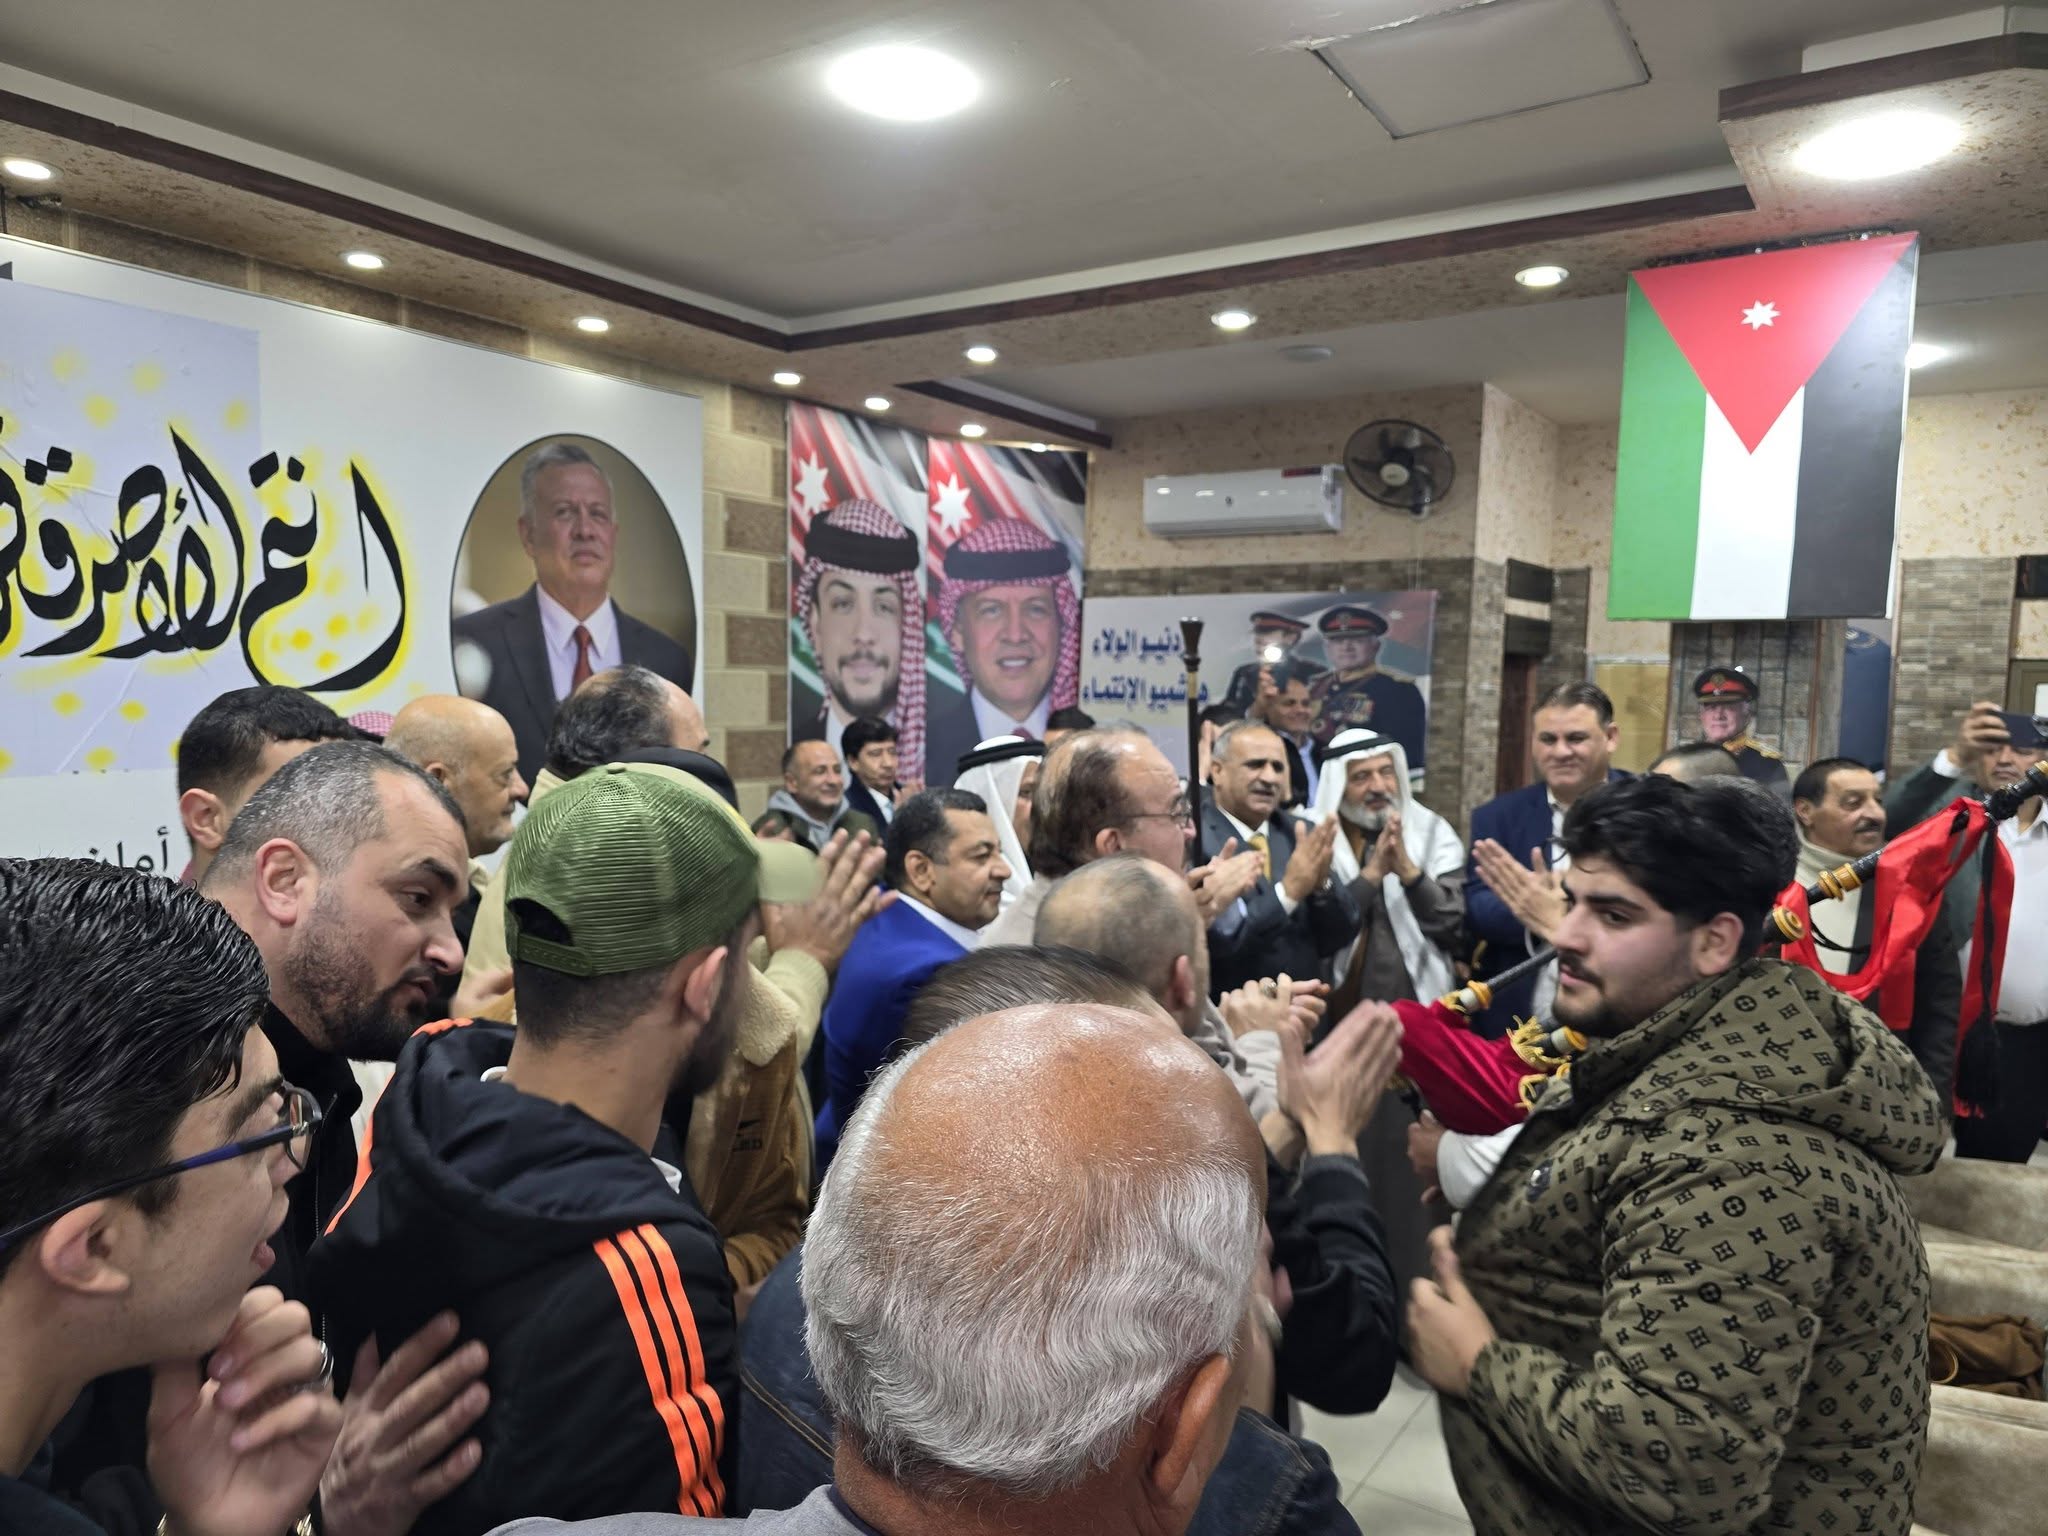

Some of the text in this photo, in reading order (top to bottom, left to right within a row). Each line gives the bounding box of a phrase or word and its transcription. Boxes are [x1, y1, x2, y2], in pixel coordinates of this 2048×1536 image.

[1092, 627, 1184, 664] دنيو الولاء
[1147, 673, 1209, 713] هشميو
